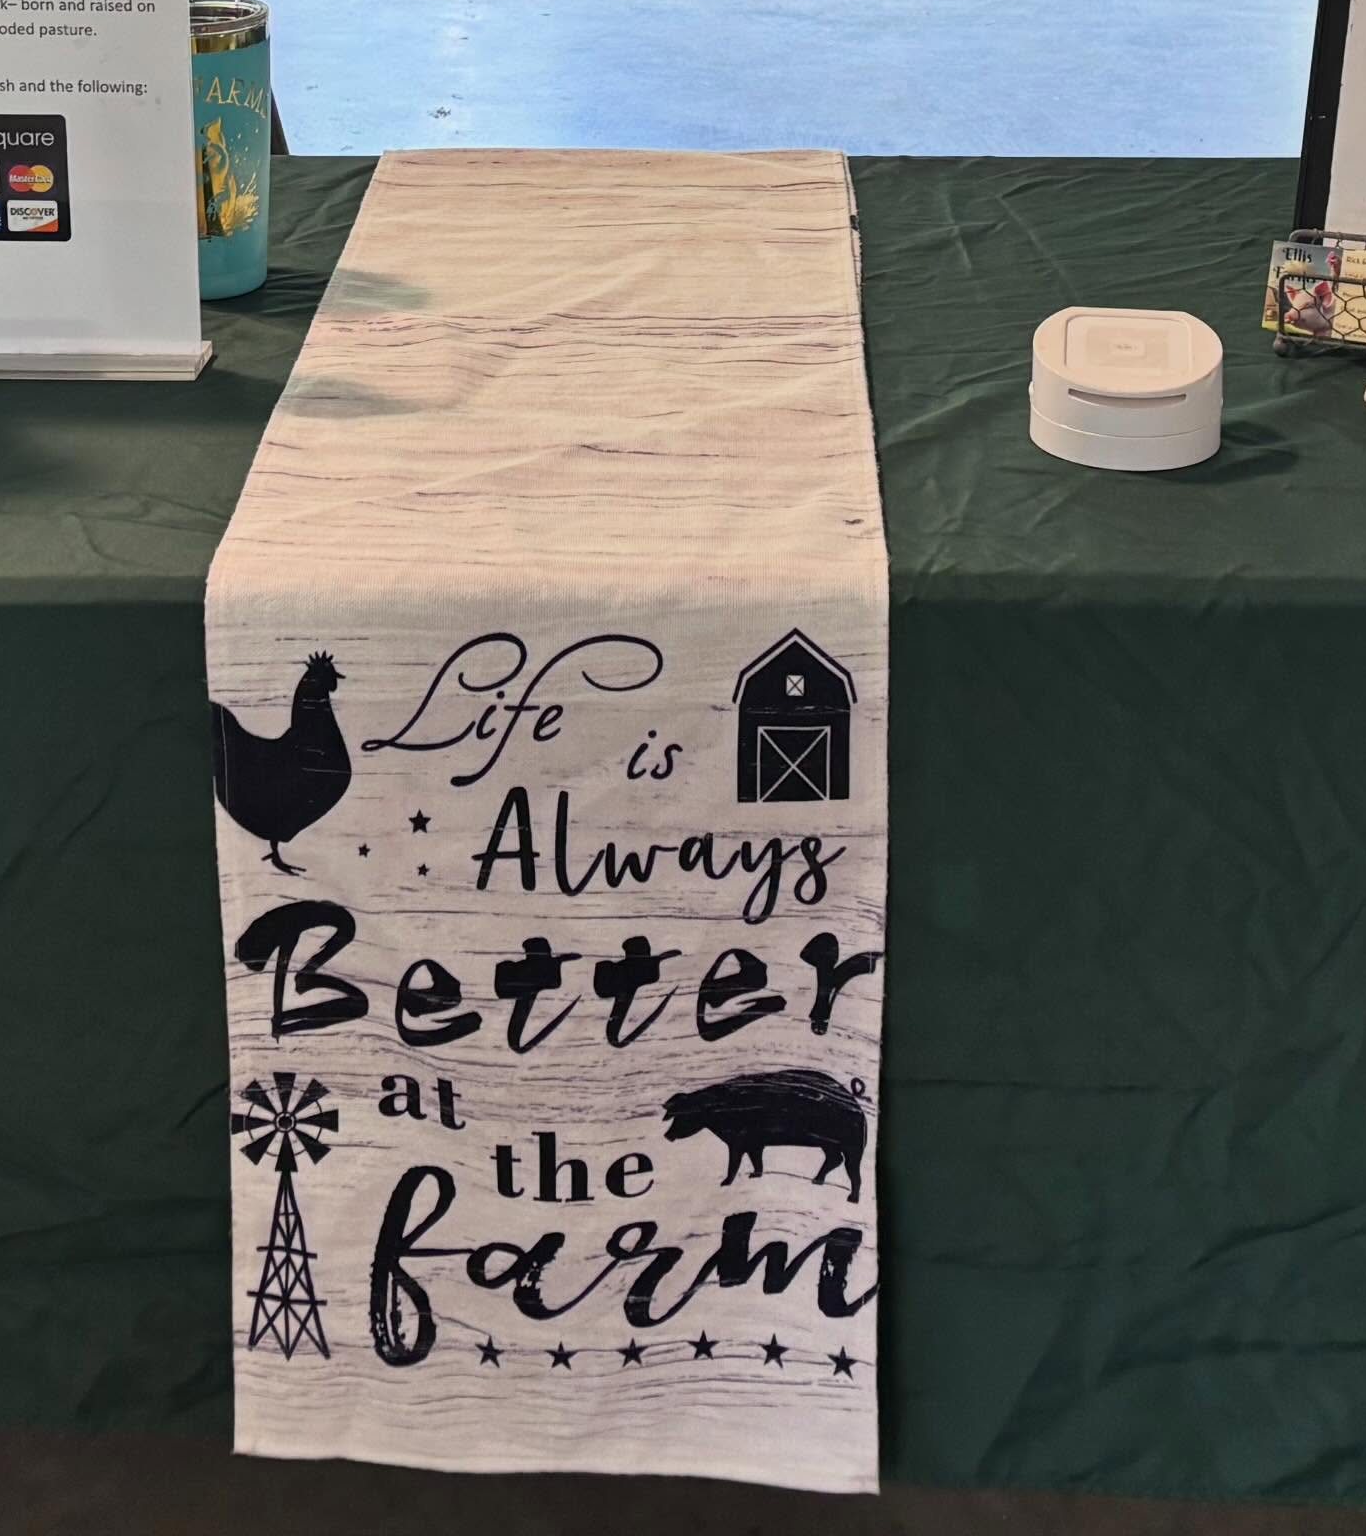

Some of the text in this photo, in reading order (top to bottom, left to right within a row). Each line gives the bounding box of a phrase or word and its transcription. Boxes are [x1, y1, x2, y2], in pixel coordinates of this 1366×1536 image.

[39, 23, 98, 39] pasture.
[59, 0, 85, 12] and
[90, 0, 133, 13] raised
[137, 1, 156, 13] on
[19, 79, 46, 93] and
[50, 79, 73, 93] the
[76, 79, 148, 96] following:
[10, 207, 56, 217] DISCOVER
[1283, 247, 1313, 264] Ellis
[361, 632, 663, 787] Life
[626, 730, 683, 780] is
[471, 785, 848, 925] Always
[234, 900, 885, 1054] Better
[378, 1073, 467, 1131] at
[488, 1131, 656, 1203] the
[368, 1165, 881, 1367] farm
